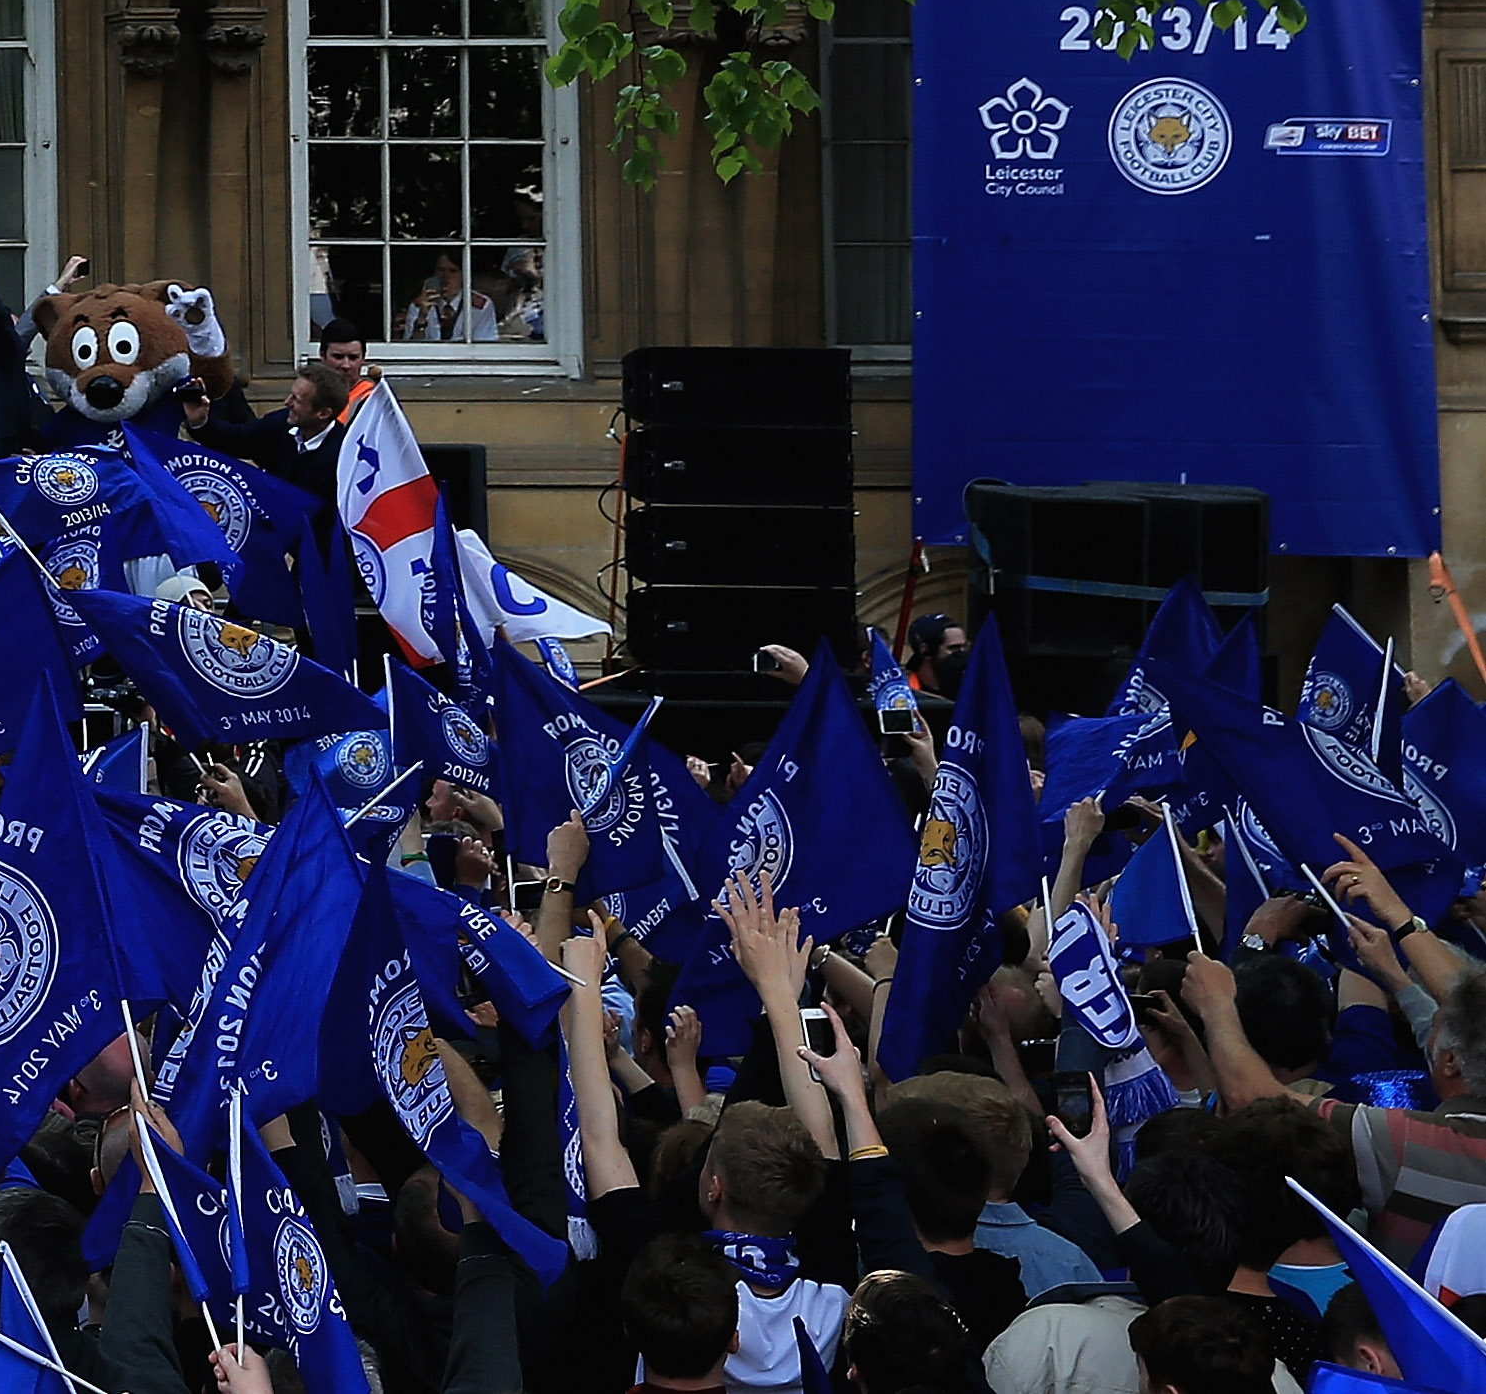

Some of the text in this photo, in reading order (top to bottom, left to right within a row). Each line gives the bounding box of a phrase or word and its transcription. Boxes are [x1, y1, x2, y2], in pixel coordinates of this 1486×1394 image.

[1121, 88, 1220, 133] LEICESTER CITY
[1347, 125, 1379, 140] BET
[986, 164, 1063, 182] Leicester
[1120, 140, 1220, 185] FOOTBALL CLUB
[985, 182, 1064, 198] City Council
[181, 478, 244, 524] CESTER CITY
[61, 503, 111, 527] 2013/14
[196, 649, 272, 688] FOOTBALL
[241, 705, 311, 726] MAY 2014
[443, 762, 490, 791] 2013/14
[621, 764, 645, 847] MPIONS
[1390, 817, 1428, 837] MA
